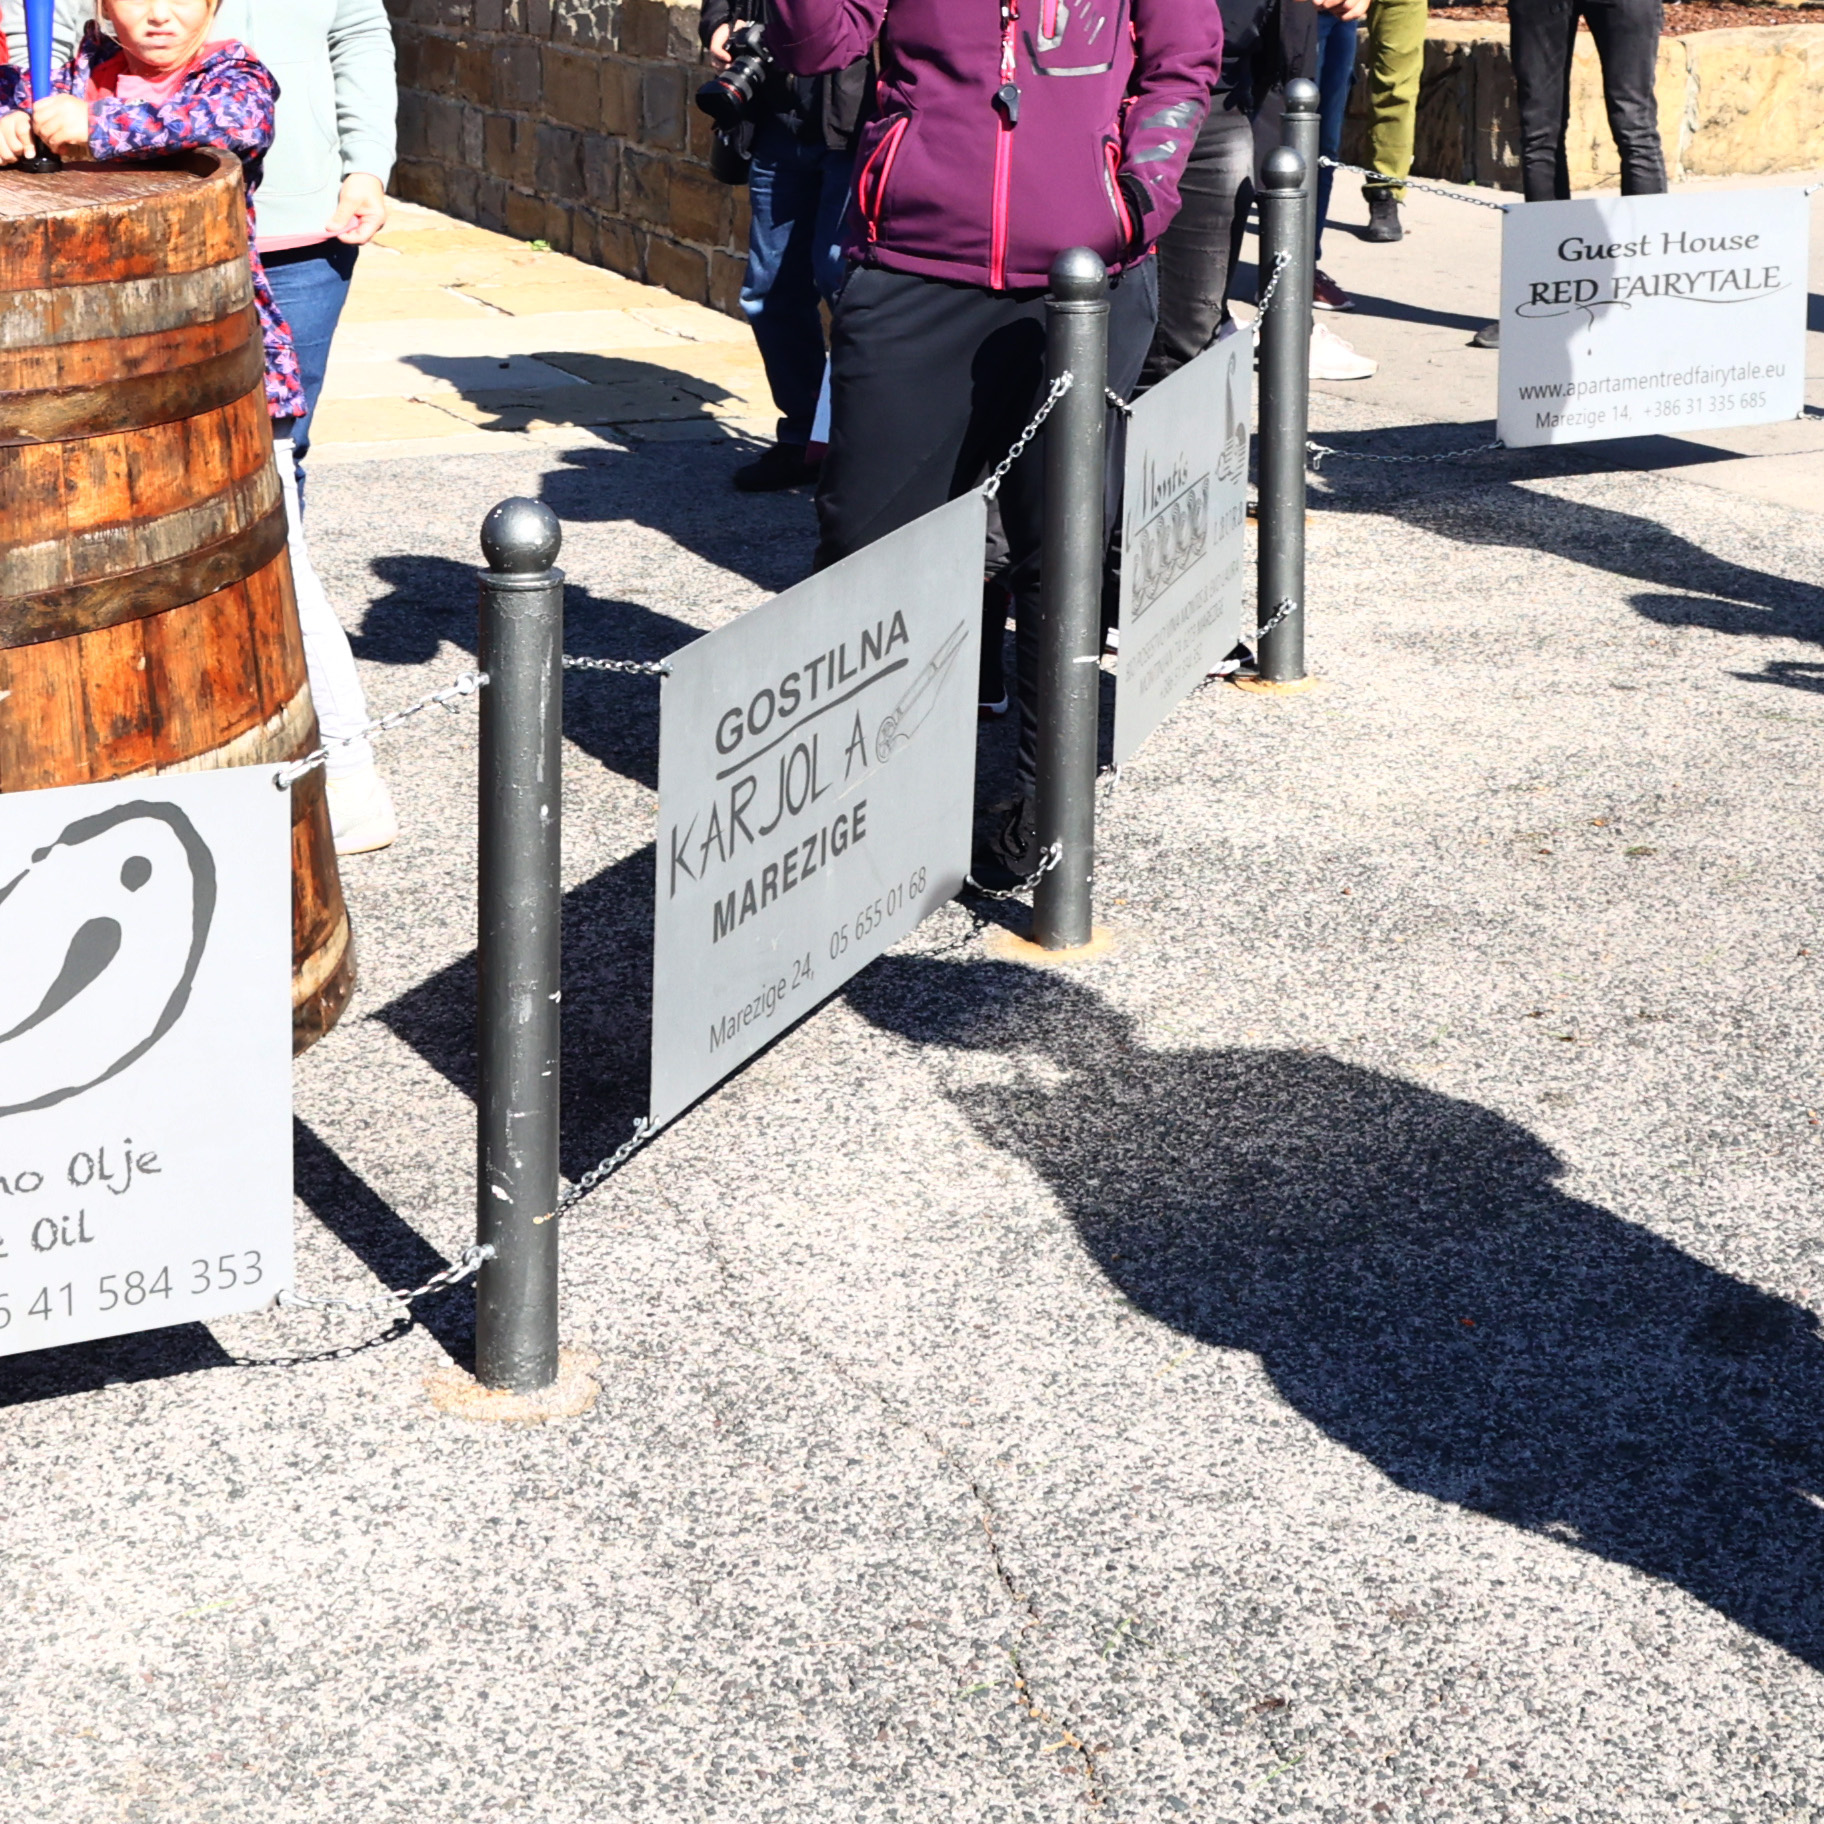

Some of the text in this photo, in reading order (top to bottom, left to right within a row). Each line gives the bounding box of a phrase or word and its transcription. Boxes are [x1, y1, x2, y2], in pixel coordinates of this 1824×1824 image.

[1558, 231, 1761, 263] Guest House
[1528, 266, 1782, 306] RED FAIRYTALE
[1519, 361, 1786, 400] www.apartamentredfairytale.eu
[1535, 407, 1607, 430] Marezige
[1643, 399, 1681, 419] +386
[1686, 397, 1704, 415] 31
[1708, 394, 1735, 412] 335
[1740, 391, 1768, 409] 685
[715, 609, 910, 755] GOSTILNA
[712, 799, 868, 944] MAREZIGE
[712, 866, 926, 1045] Marezige 24, 05 655 01 68
[68, 1138, 161, 1195] Olje
[31, 1209, 94, 1252] Oil
[28, 1283, 72, 1320] 41
[100, 1266, 172, 1310] 584
[192, 1251, 262, 1294] 353
